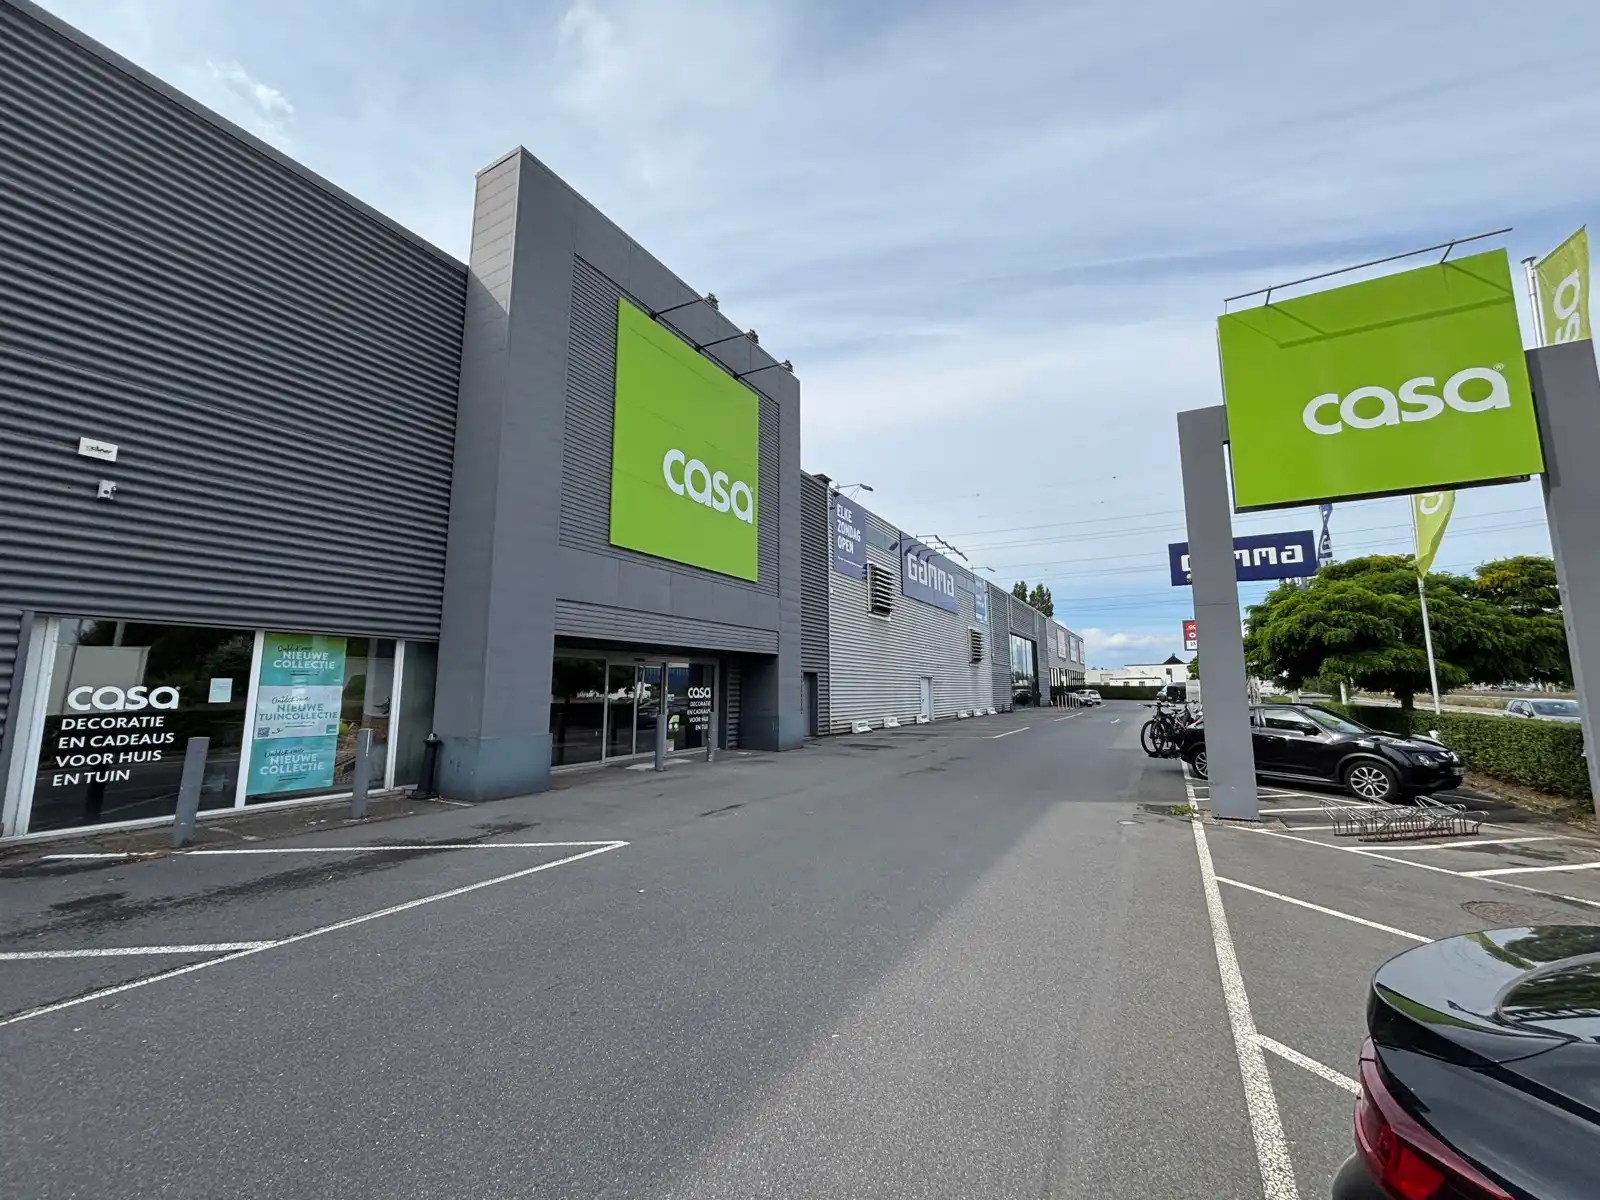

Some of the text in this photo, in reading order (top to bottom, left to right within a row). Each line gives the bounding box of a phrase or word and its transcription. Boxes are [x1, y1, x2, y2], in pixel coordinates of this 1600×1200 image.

[1302, 367, 1511, 435] casa
[662, 448, 753, 525] casa
[836, 504, 853, 523] ELKE
[837, 519, 861, 542] ZONDAG
[837, 535, 854, 554] OPEN
[272, 659, 335, 669] COLLECTIE
[283, 651, 329, 660] NIEUWE
[67, 685, 180, 711] casa
[687, 687, 711, 699] casa
[259, 711, 338, 721] TUINCOLLECTIE
[277, 703, 324, 712] NIEUWE
[61, 715, 165, 731] DECORATIE
[58, 732, 175, 749] EN CADEAUS
[55, 749, 162, 767] VOOR HUIS
[270, 753, 318, 765] NIEUWE
[260, 761, 325, 775] COLLECTIE
[52, 769, 130, 787] EN TUIN
